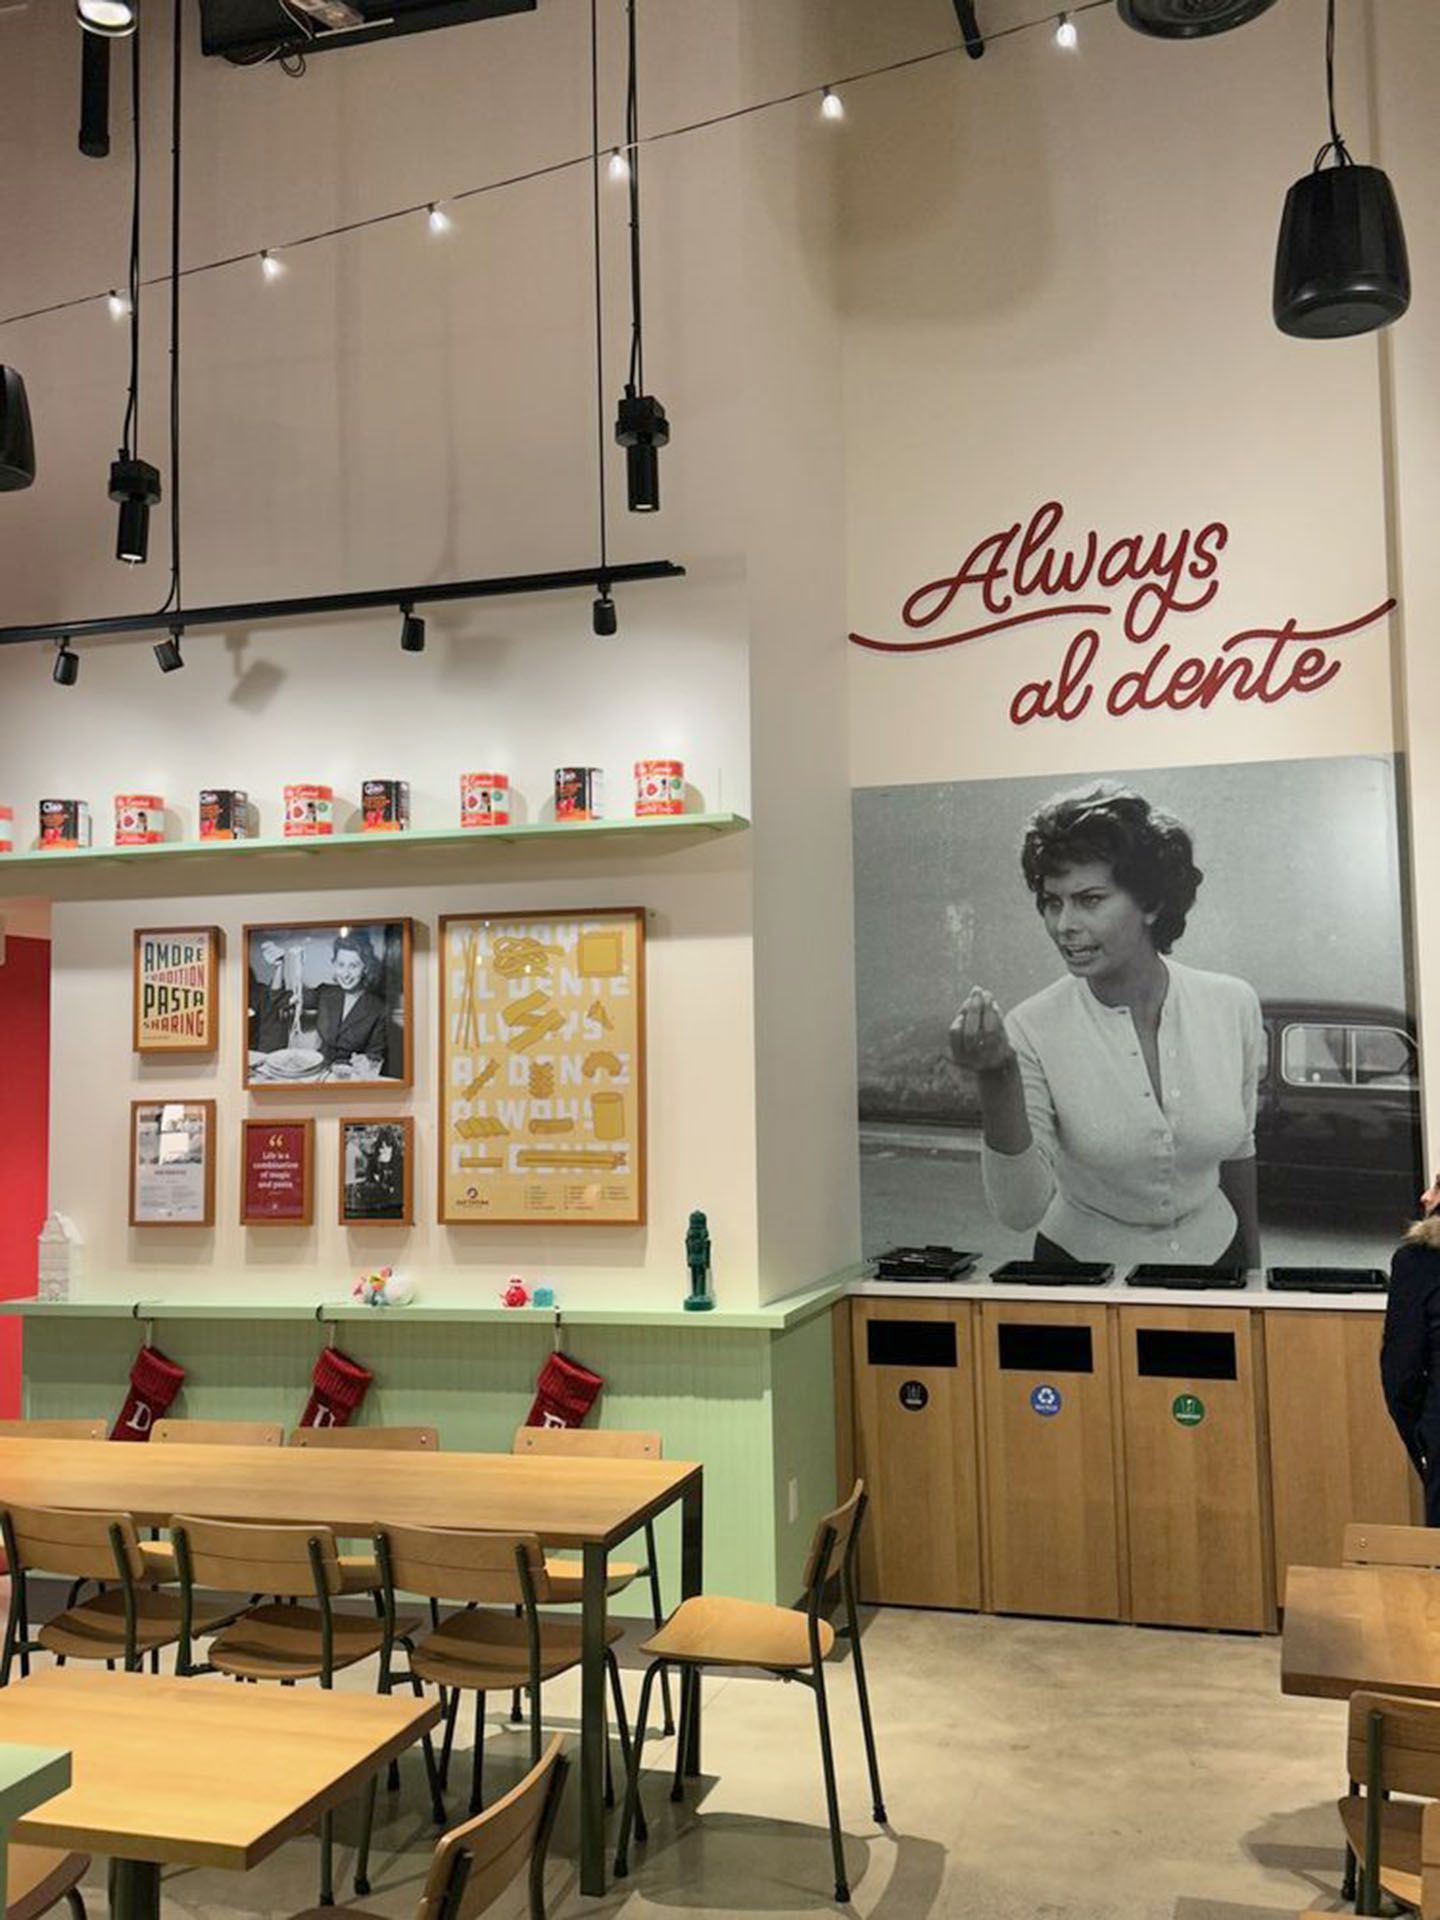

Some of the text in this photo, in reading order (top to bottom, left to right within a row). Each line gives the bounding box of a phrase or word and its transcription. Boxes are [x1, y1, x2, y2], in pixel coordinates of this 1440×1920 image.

[902, 501, 1229, 644] Always
[1009, 610, 1375, 726] al dente
[143, 941, 204, 973] AMORE
[143, 983, 204, 1019] PASTA
[143, 1009, 204, 1038] SHARING
[125, 1400, 152, 1432] D
